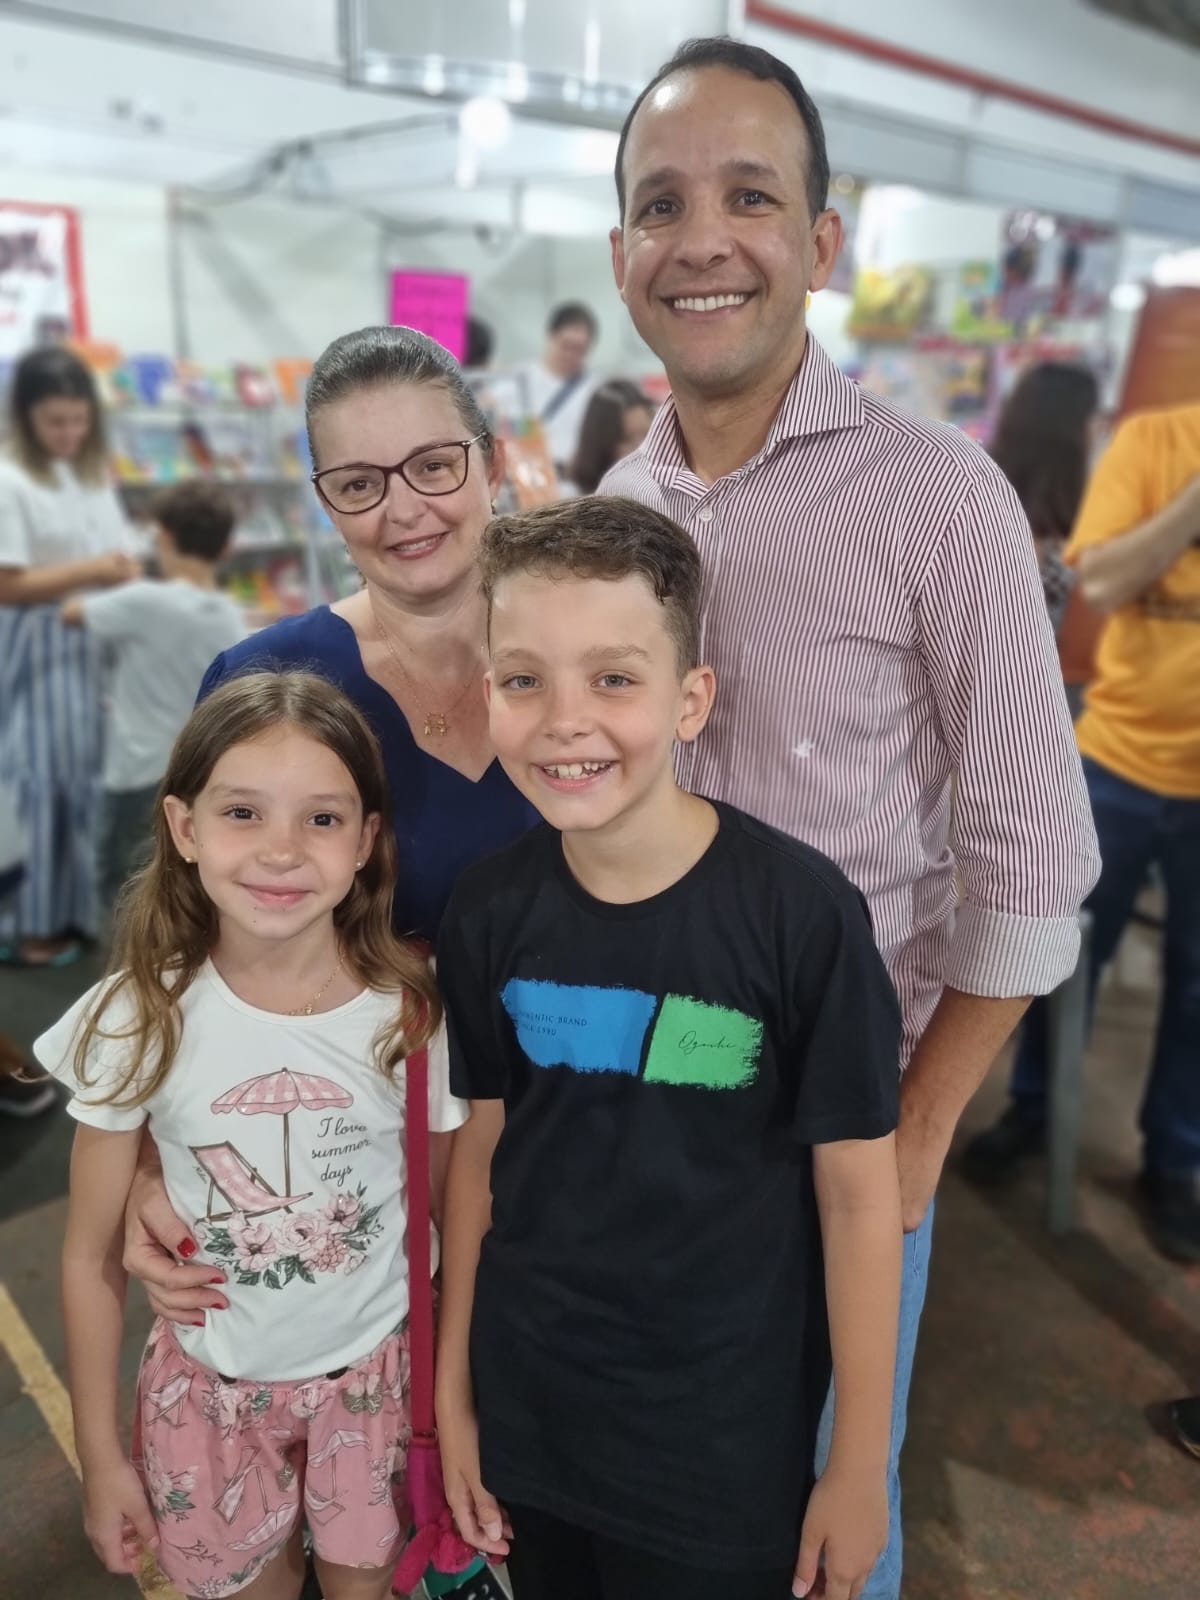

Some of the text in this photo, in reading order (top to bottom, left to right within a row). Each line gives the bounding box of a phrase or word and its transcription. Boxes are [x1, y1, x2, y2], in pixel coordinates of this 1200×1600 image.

[558, 1015, 588, 1027] BRAND
[317, 1116, 367, 1138] I love
[312, 1139, 372, 1159] summer
[320, 1163, 353, 1187] days
